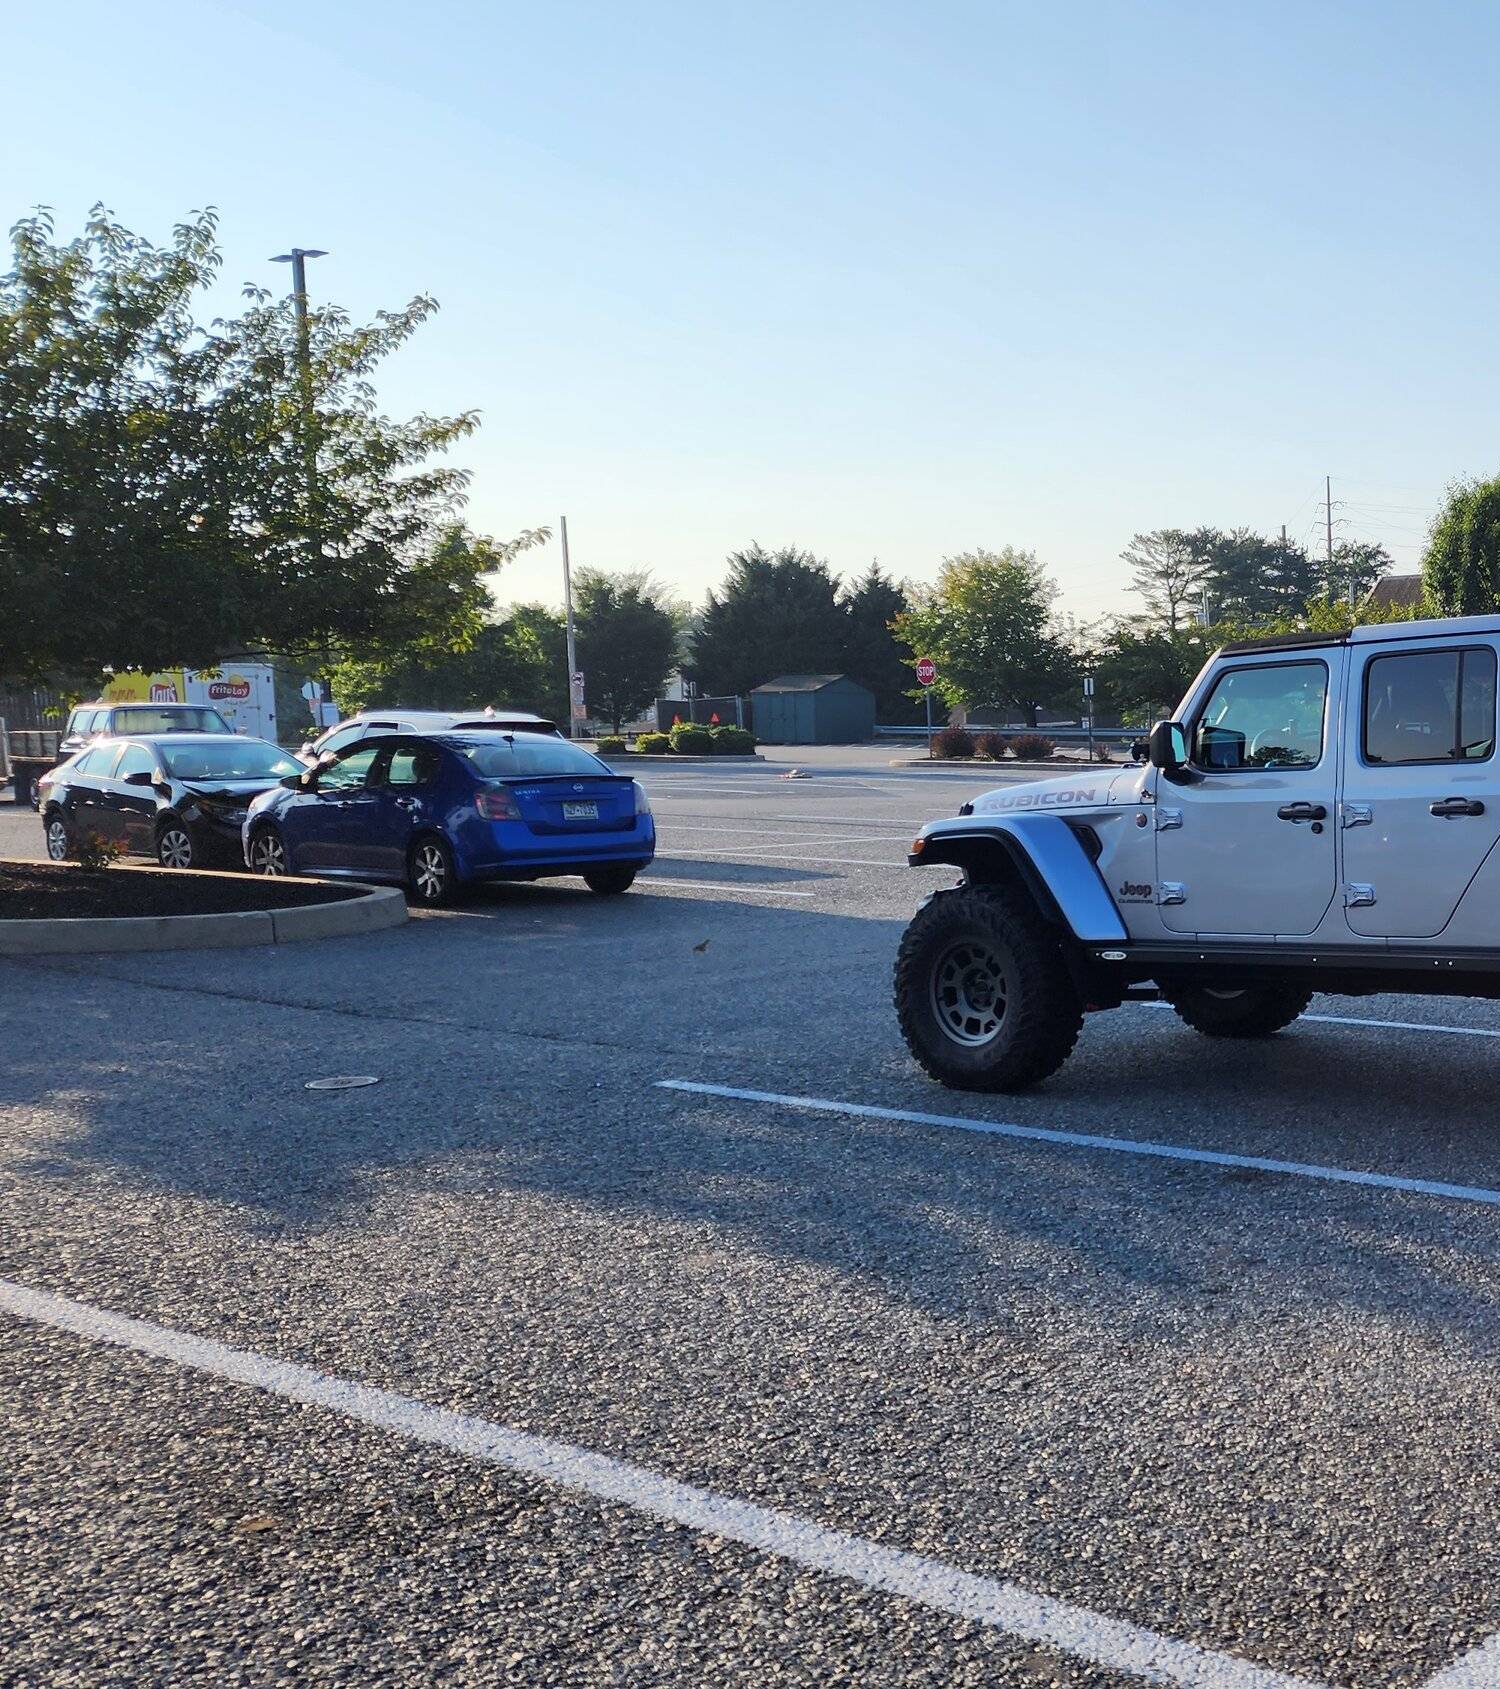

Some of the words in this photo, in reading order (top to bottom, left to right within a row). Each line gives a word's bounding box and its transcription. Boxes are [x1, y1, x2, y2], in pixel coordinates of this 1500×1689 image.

[918, 666, 933, 676] STOP
[981, 788, 1097, 811] RUBICON
[1119, 881, 1152, 898] Jeep
